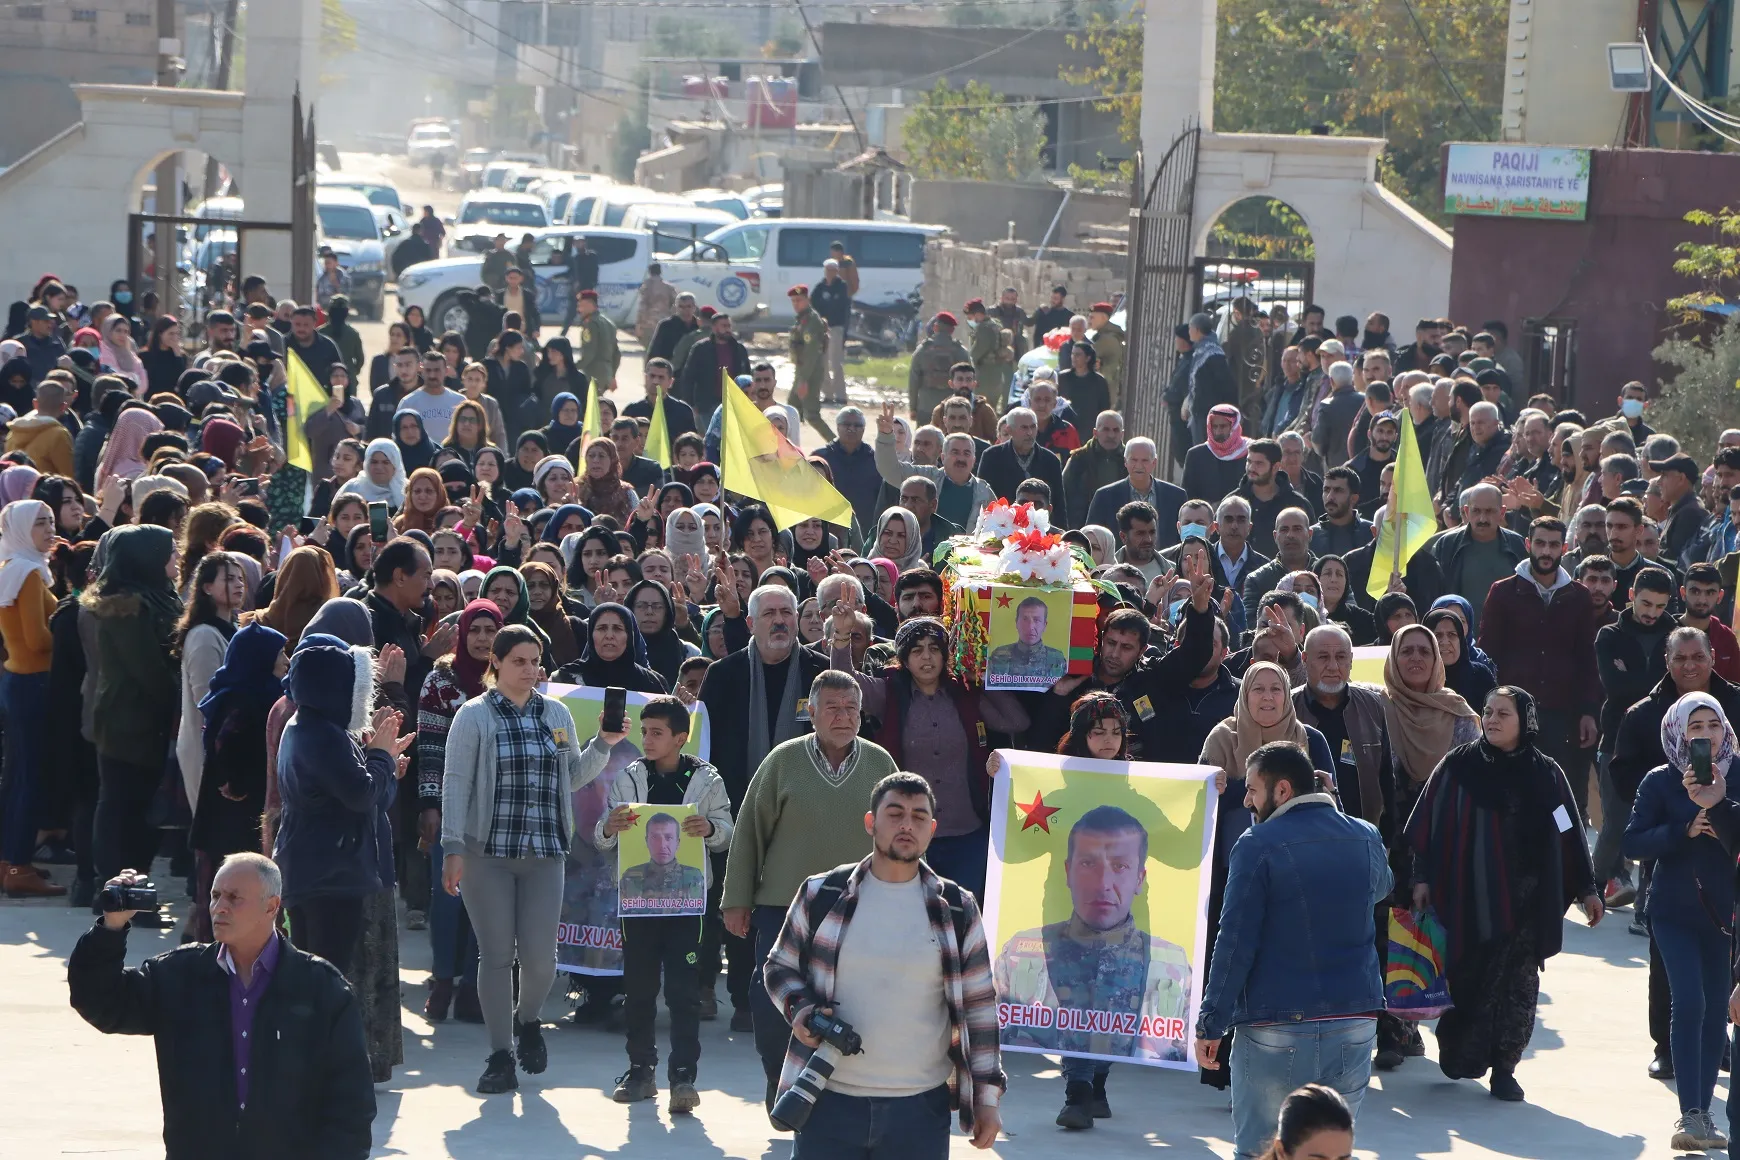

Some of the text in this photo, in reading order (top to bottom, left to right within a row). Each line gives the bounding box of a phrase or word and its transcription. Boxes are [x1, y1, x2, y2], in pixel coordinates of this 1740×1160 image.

[1492, 151, 1539, 171] PAQIJI
[622, 896, 646, 910] ŞEHÎD
[684, 898, 703, 908] AGIR
[998, 1001, 1184, 1040] ŞEHÎD DILXUAZ AGIR
